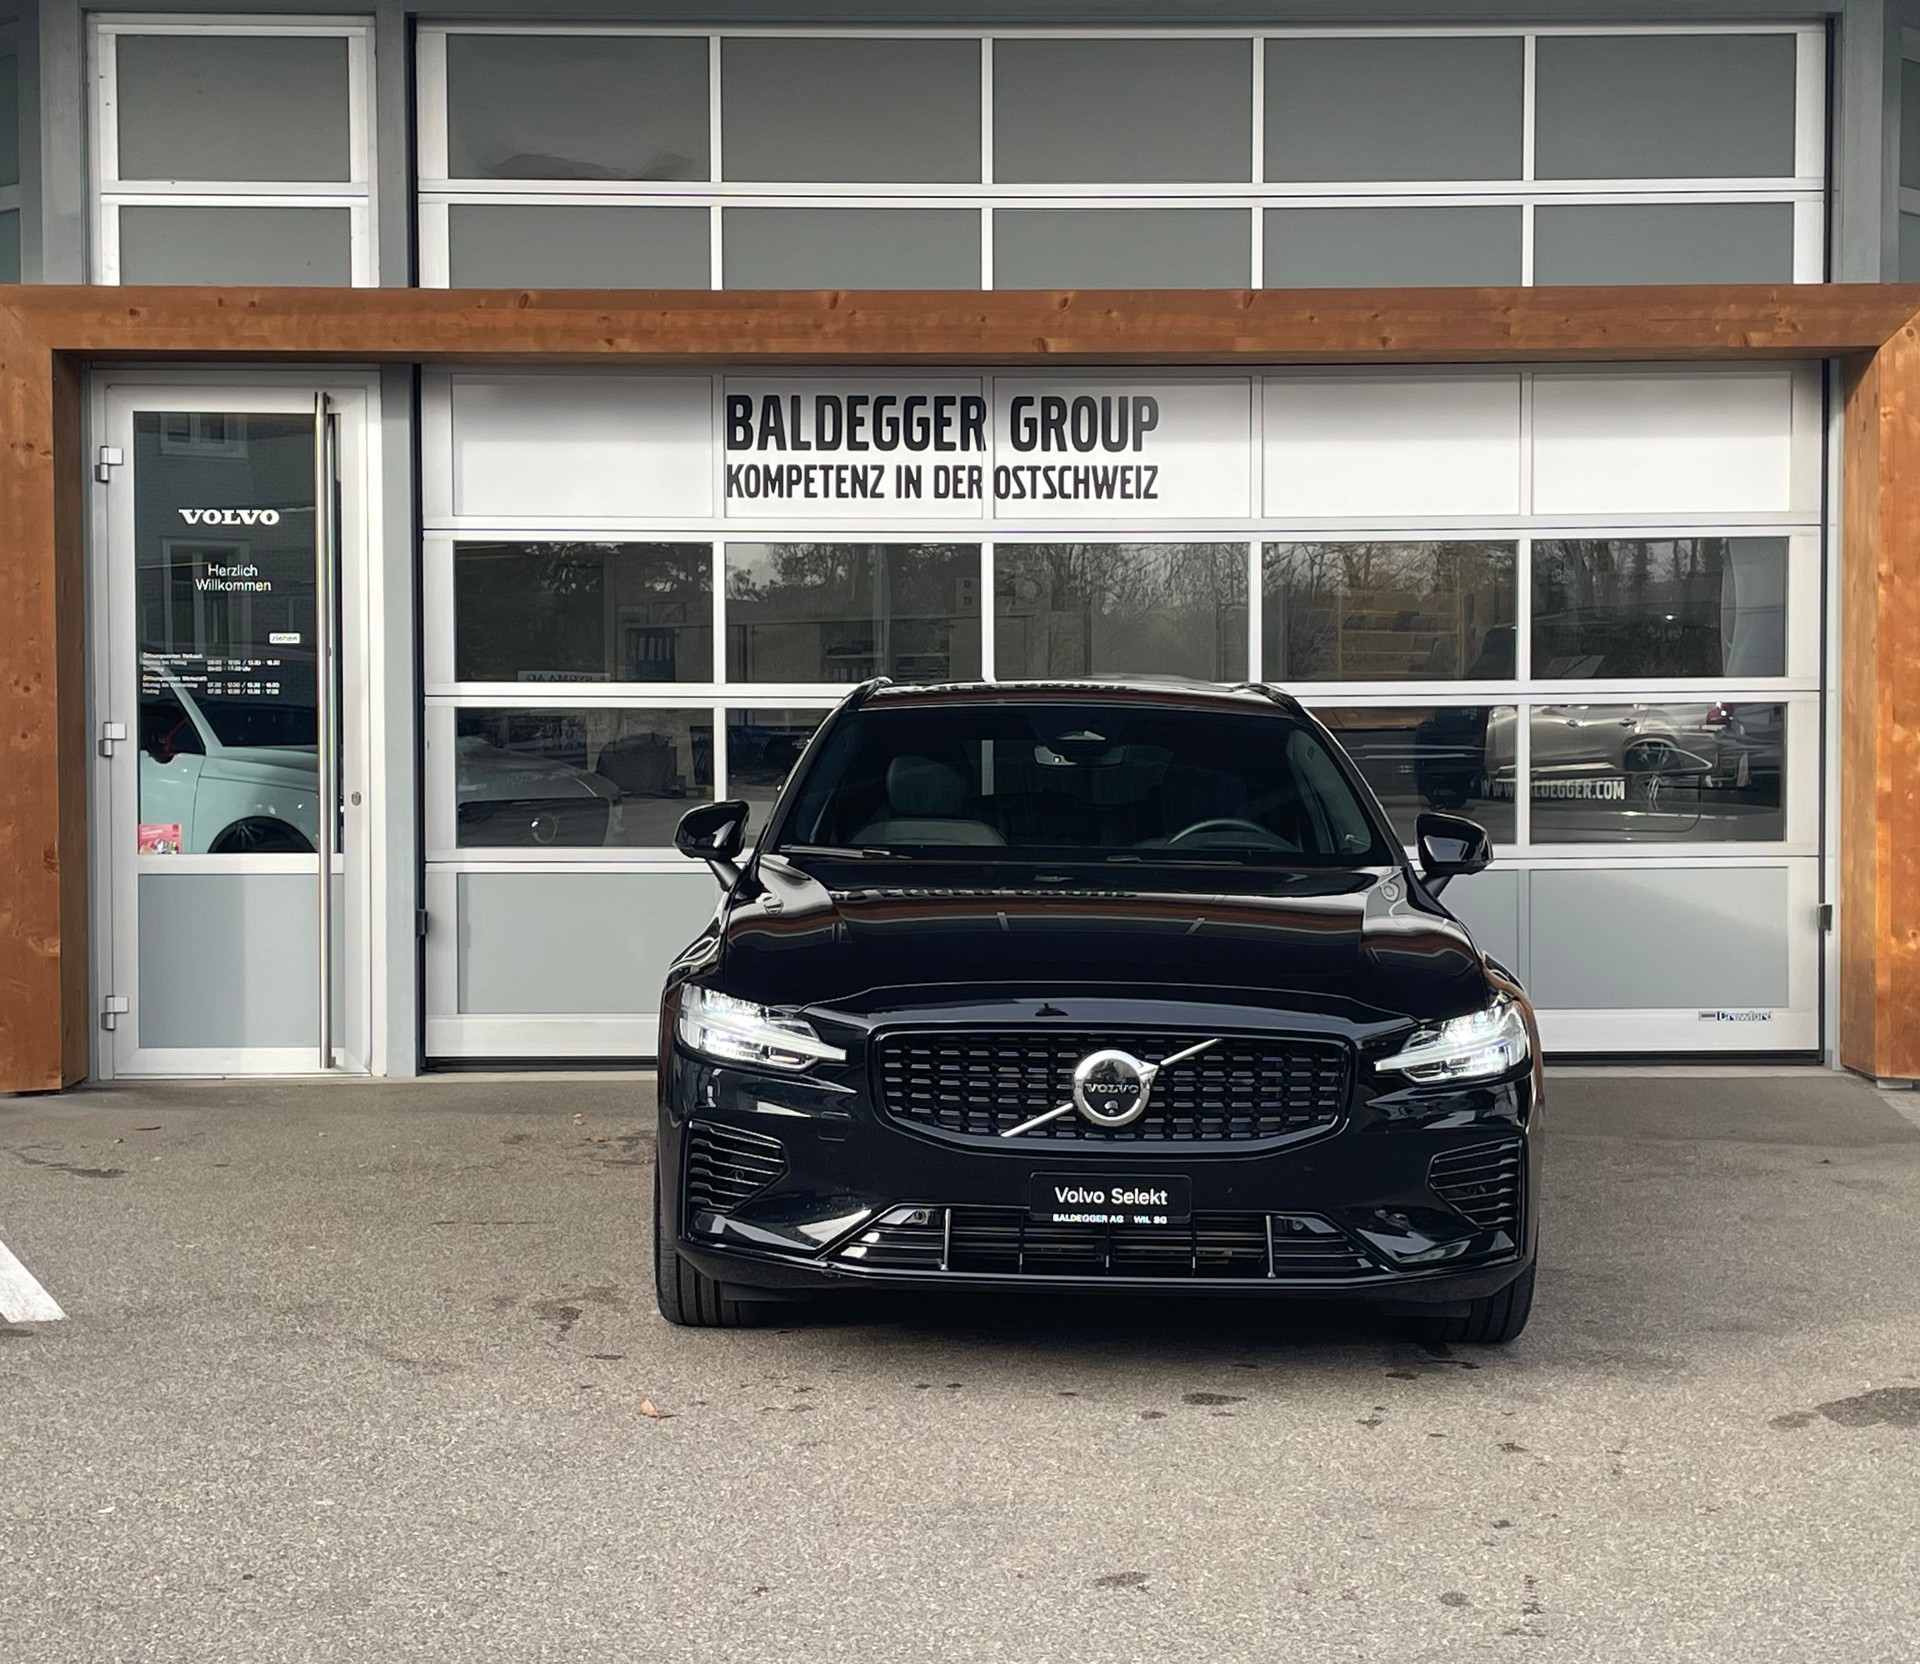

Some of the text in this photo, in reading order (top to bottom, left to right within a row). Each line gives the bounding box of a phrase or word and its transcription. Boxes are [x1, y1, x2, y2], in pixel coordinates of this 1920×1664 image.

[726, 394, 1159, 453] BALDEGGER GROUP
[726, 464, 1159, 499] KOMPETENZ IN DER OSTSCHWEIZ
[178, 509, 280, 525] VOLVO
[208, 563, 258, 576] Herzlich
[195, 578, 272, 591] Willkommen
[1084, 1083, 1139, 1094] VOLVO
[1054, 1186, 1168, 1205] Volvo Selekt
[1052, 1213, 1108, 1223] BALDEGGER
[1109, 1215, 1124, 1223] AG
[1133, 1215, 1151, 1224] WIL
